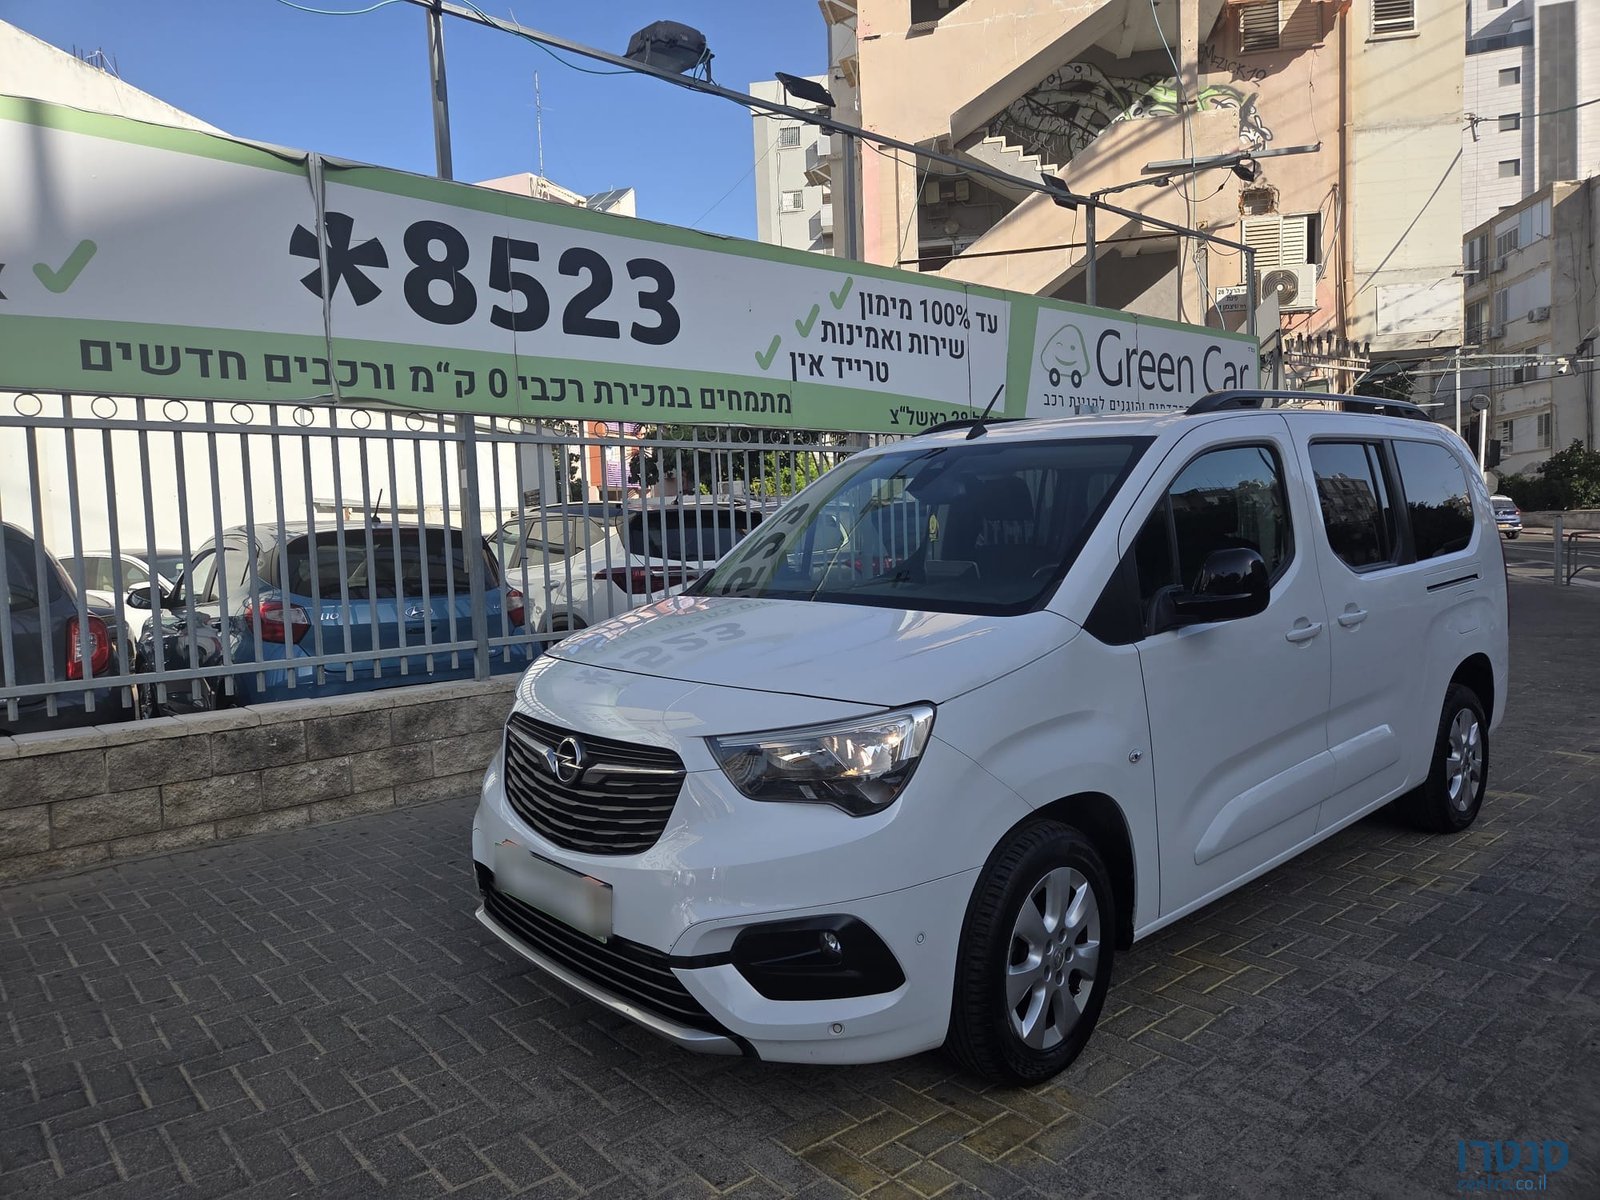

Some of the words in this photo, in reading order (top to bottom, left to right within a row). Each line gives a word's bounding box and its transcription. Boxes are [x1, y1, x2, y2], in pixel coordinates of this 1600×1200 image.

[859, 291, 913, 320] מימון
[919, 299, 971, 330] 100%
[820, 320, 902, 352] ואמינות
[976, 312, 998, 334] עד
[80, 339, 247, 380] חדשים
[908, 332, 965, 359] שירות
[264, 354, 395, 390] ורכבים
[789, 351, 824, 382] אין
[831, 356, 889, 383] טרייד
[1096, 329, 1195, 394] Green
[1203, 345, 1249, 393] Car
[488, 368, 508, 398] 0
[517, 376, 584, 403] רכבי
[593, 381, 692, 408] במכירת
[700, 388, 792, 413] מתמחים
[1043, 393, 1064, 407] רכב
